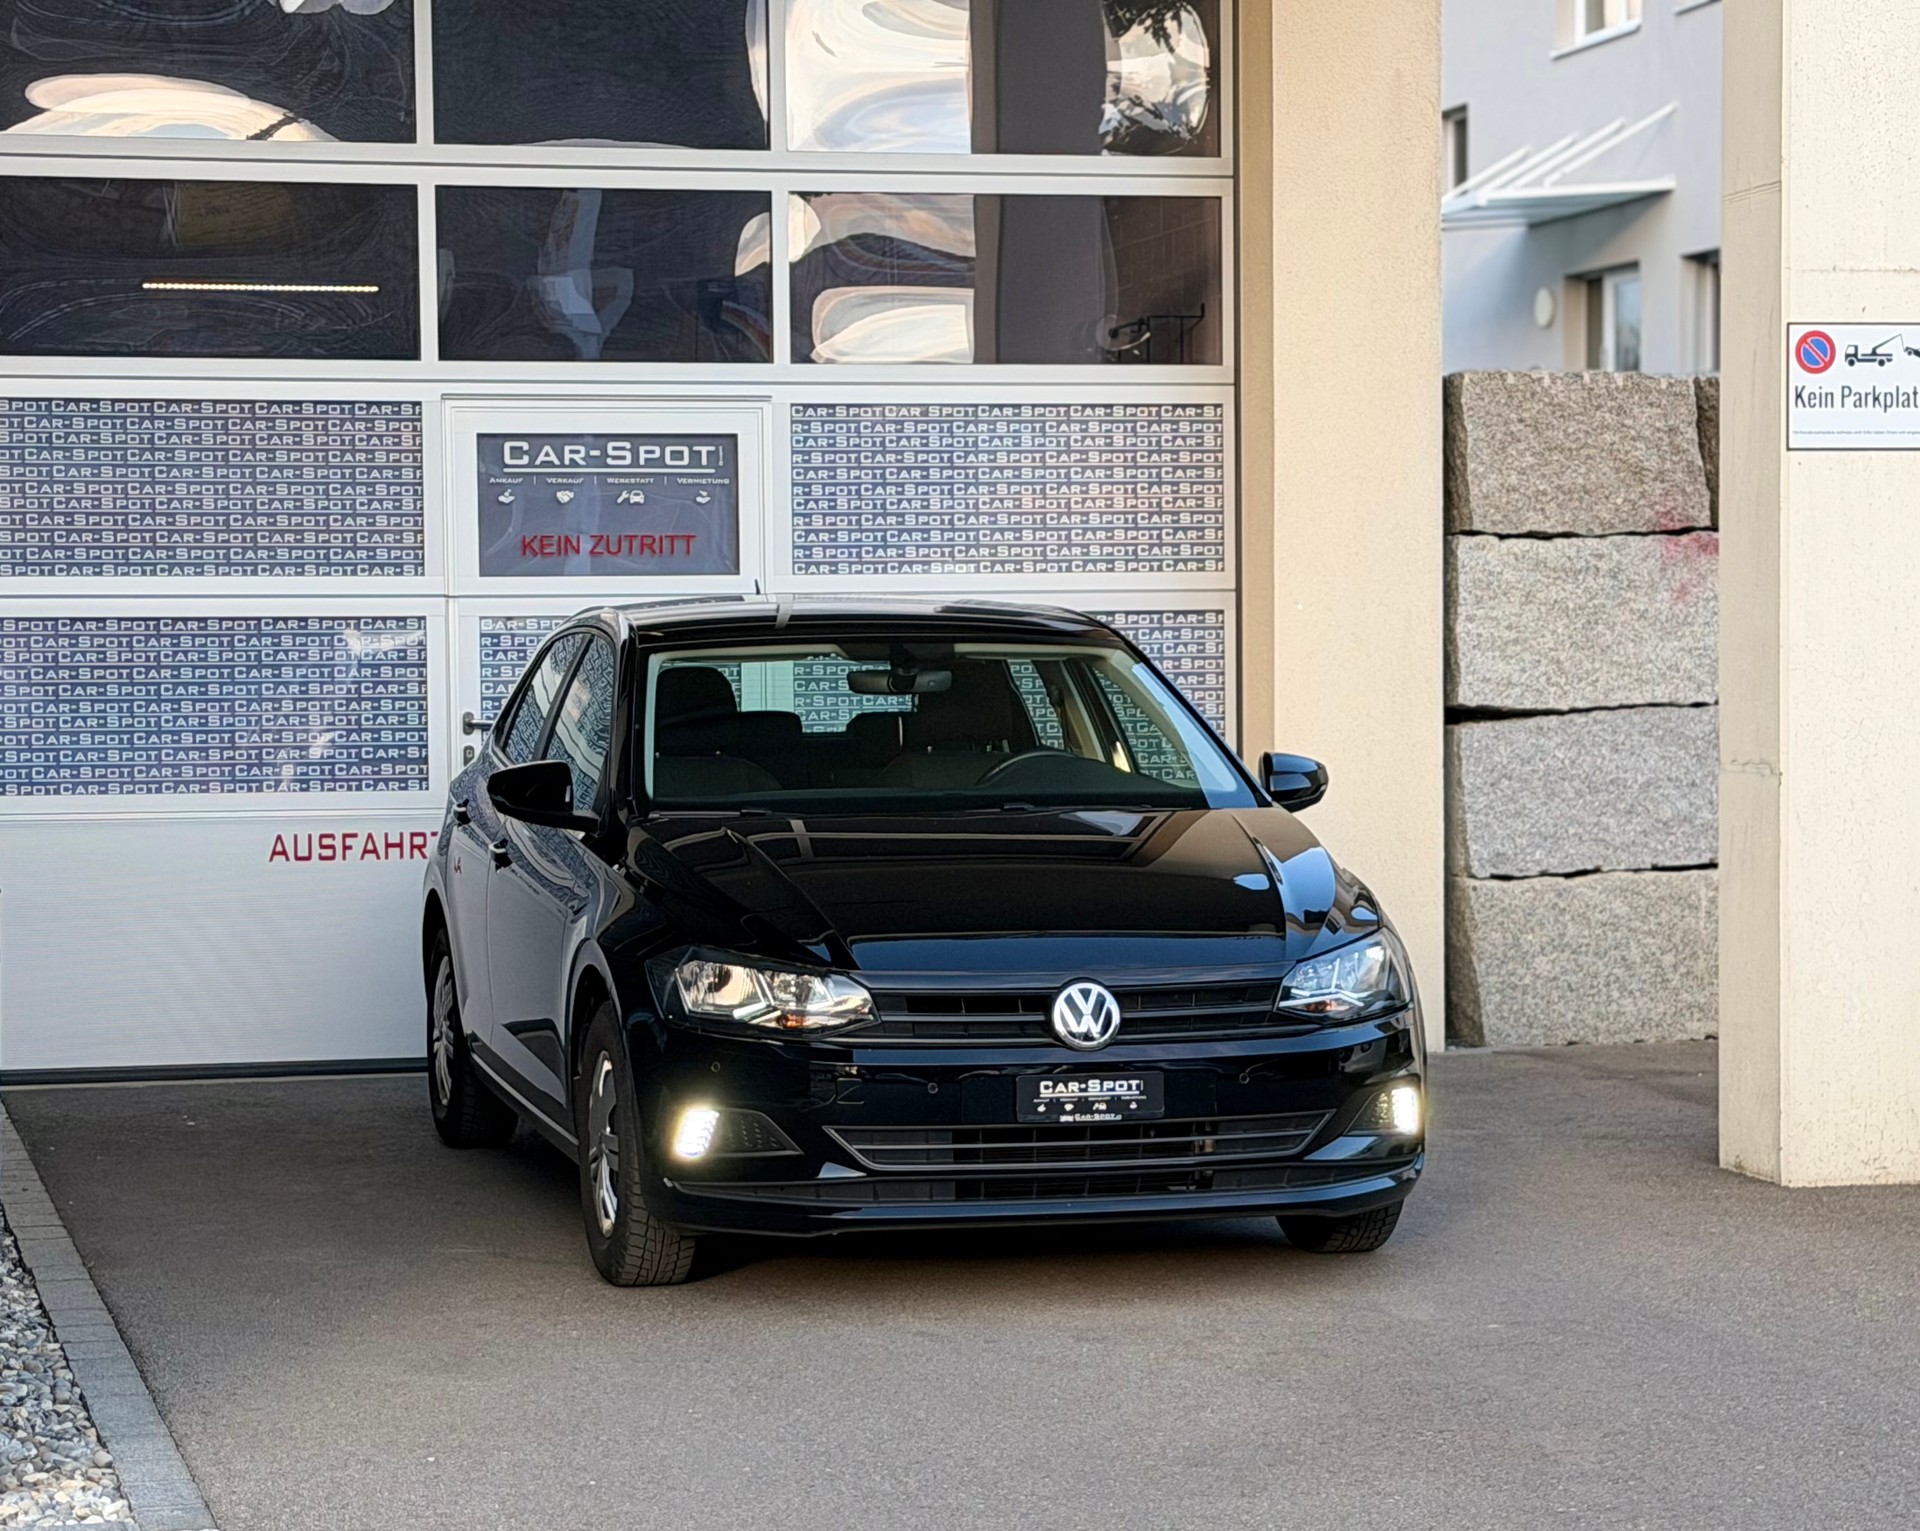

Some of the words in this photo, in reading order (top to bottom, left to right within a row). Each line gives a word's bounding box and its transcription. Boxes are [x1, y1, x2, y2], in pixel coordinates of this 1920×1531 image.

[1795, 385, 1834, 408] Kein
[1841, 385, 1919, 413] Parkplat
[52, 400, 152, 413] CAR-SPOT
[154, 401, 252, 414] CAR-SPOT
[255, 402, 352, 415] CAR-SPOT
[791, 406, 883, 417] CAR-SPOT
[977, 406, 1068, 417] CAR-SPOT
[1070, 406, 1159, 417] CAR-SPOT
[24, 416, 124, 429] CAR-SPOT
[126, 417, 225, 430] CAR-SPOT
[228, 418, 326, 431] CAR-SPOT
[860, 422, 951, 433] CAR-SPOT
[953, 422, 1043, 433] CAR-SPOT
[1045, 422, 1135, 433] CAR-SPOT
[52, 432, 153, 444] CAR-SPOT
[154, 433, 252, 445] CAR-SPOT
[255, 434, 353, 446] CAR-SPOT
[792, 436, 884, 448] CAR-SPOT
[885, 436, 977, 447] CAR-SPOT
[977, 436, 1068, 447] CAR-SPOT
[1070, 436, 1159, 447] CAR-SPOT
[24, 448, 125, 461] CAR-SPOT
[126, 449, 226, 461] CAR-SPOT
[228, 450, 327, 462] CAR-SPOT
[503, 441, 716, 466] CAR-SPOT
[860, 452, 951, 464] CAR-SPOT
[953, 452, 1044, 463] CAR-SPOT
[53, 465, 153, 478] CAR-SPOT
[155, 466, 253, 478] CAR-SPOT
[255, 467, 354, 479] CAR-SPOT
[792, 468, 884, 480] CAR-SPOT
[885, 468, 977, 480] CAR-SPOT
[978, 468, 1068, 479] CAR-SPOT
[1070, 468, 1160, 479] CAR-SPOT
[25, 482, 125, 494] CAR-SPOT
[127, 482, 226, 495] CAR-SPOT
[229, 483, 327, 495] CAR-SPOT
[860, 484, 951, 496] CAR-SPOT
[954, 484, 1044, 495] CAR-SPOT
[1045, 483, 1135, 495] CAR-SPOT
[53, 497, 154, 509] CAR-SPOT
[155, 498, 253, 510] CAR-SPOT
[256, 498, 355, 510] CAR-SPOT
[793, 498, 884, 510] CAR-SPOT
[886, 498, 977, 510] CAR-SPOT
[978, 498, 1068, 509] CAR-SPOT
[1071, 497, 1160, 509] CAR-SPOT
[25, 513, 126, 526] CAR-SPOT
[127, 514, 227, 526] CAR-SPOT
[229, 514, 328, 526] CAR-SPOT
[861, 514, 952, 526] CAR-SPOT
[954, 514, 1044, 526] CAR-SPOT
[1046, 513, 1136, 525] CAR-SPOT
[54, 531, 155, 543] CAR-SPOT
[156, 531, 254, 543] CAR-SPOT
[256, 531, 356, 543] CAR-SPOT
[793, 531, 885, 542] CAR-SPOT
[886, 530, 977, 542] CAR-SPOT
[979, 530, 1068, 541] CAR-SPOT
[1071, 529, 1160, 541] CAR-SPOT
[521, 535, 581, 557] KEIN
[589, 534, 697, 557] ZUTRITT
[861, 546, 952, 558] CAR-SPOT
[955, 545, 1044, 558] CAR-SPOT
[1046, 545, 1136, 557] CAR-SPOT
[26, 548, 127, 559] CAR-SPOT
[128, 548, 227, 560] CAR-SPOT
[229, 548, 328, 560] CAR-SPOT
[55, 564, 155, 576] CAR-SPOT
[156, 564, 254, 576] CAR-SPOT
[257, 565, 356, 576] CAR-SPOT
[794, 563, 885, 575] CAR-SPOT
[887, 562, 977, 574] CAR-SPOT
[979, 561, 1068, 573] CAR-SPOT
[1071, 560, 1161, 573] CAR-SPOT
[58, 619, 158, 631] CAR-SPOT
[159, 619, 258, 631] CAR-SPOT
[260, 618, 359, 630] CAR-SPOT
[30, 636, 130, 648] CAR-SPOT
[132, 636, 231, 647] CAR-SPOT
[233, 635, 331, 647] CAR-SPOT
[58, 650, 158, 662] CAR-SPOT
[160, 650, 258, 662] CAR-SPOT
[261, 649, 359, 661] CAR-SPOT
[30, 667, 130, 680] CAR-SPOT
[132, 667, 232, 679] CAR-SPOT
[234, 667, 332, 679] CAR-SPOT
[58, 684, 158, 696] CAR-SPOT
[160, 684, 259, 696] CAR-SPOT
[261, 683, 359, 695] CAR-SPOT
[31, 701, 131, 713] CAR-SPOT
[133, 700, 232, 713] CAR-SPOT
[234, 700, 332, 712] CAR-SPOT
[59, 716, 159, 728] CAR-SPOT
[161, 715, 259, 727] CAR-SPOT
[262, 714, 359, 726] CAR-SPOT
[31, 733, 131, 745] CAR-SPOT
[133, 732, 232, 744] CAR-SPOT
[59, 749, 159, 762] CAR-SPOT
[161, 748, 260, 761] CAR-SPOT
[262, 747, 359, 760] CAR-SPOT
[32, 766, 131, 779] CAR-SPOT
[134, 765, 232, 778] CAR-SPOT
[235, 764, 332, 777] CAR-SPOT
[60, 782, 159, 795] CAR-SPOT
[162, 781, 260, 794] CAR-SPOT
[263, 780, 359, 793] CAR-SPOT
[268, 831, 438, 862] AUSFAHR
[1040, 1079, 1140, 1094] CAR-SPOT
